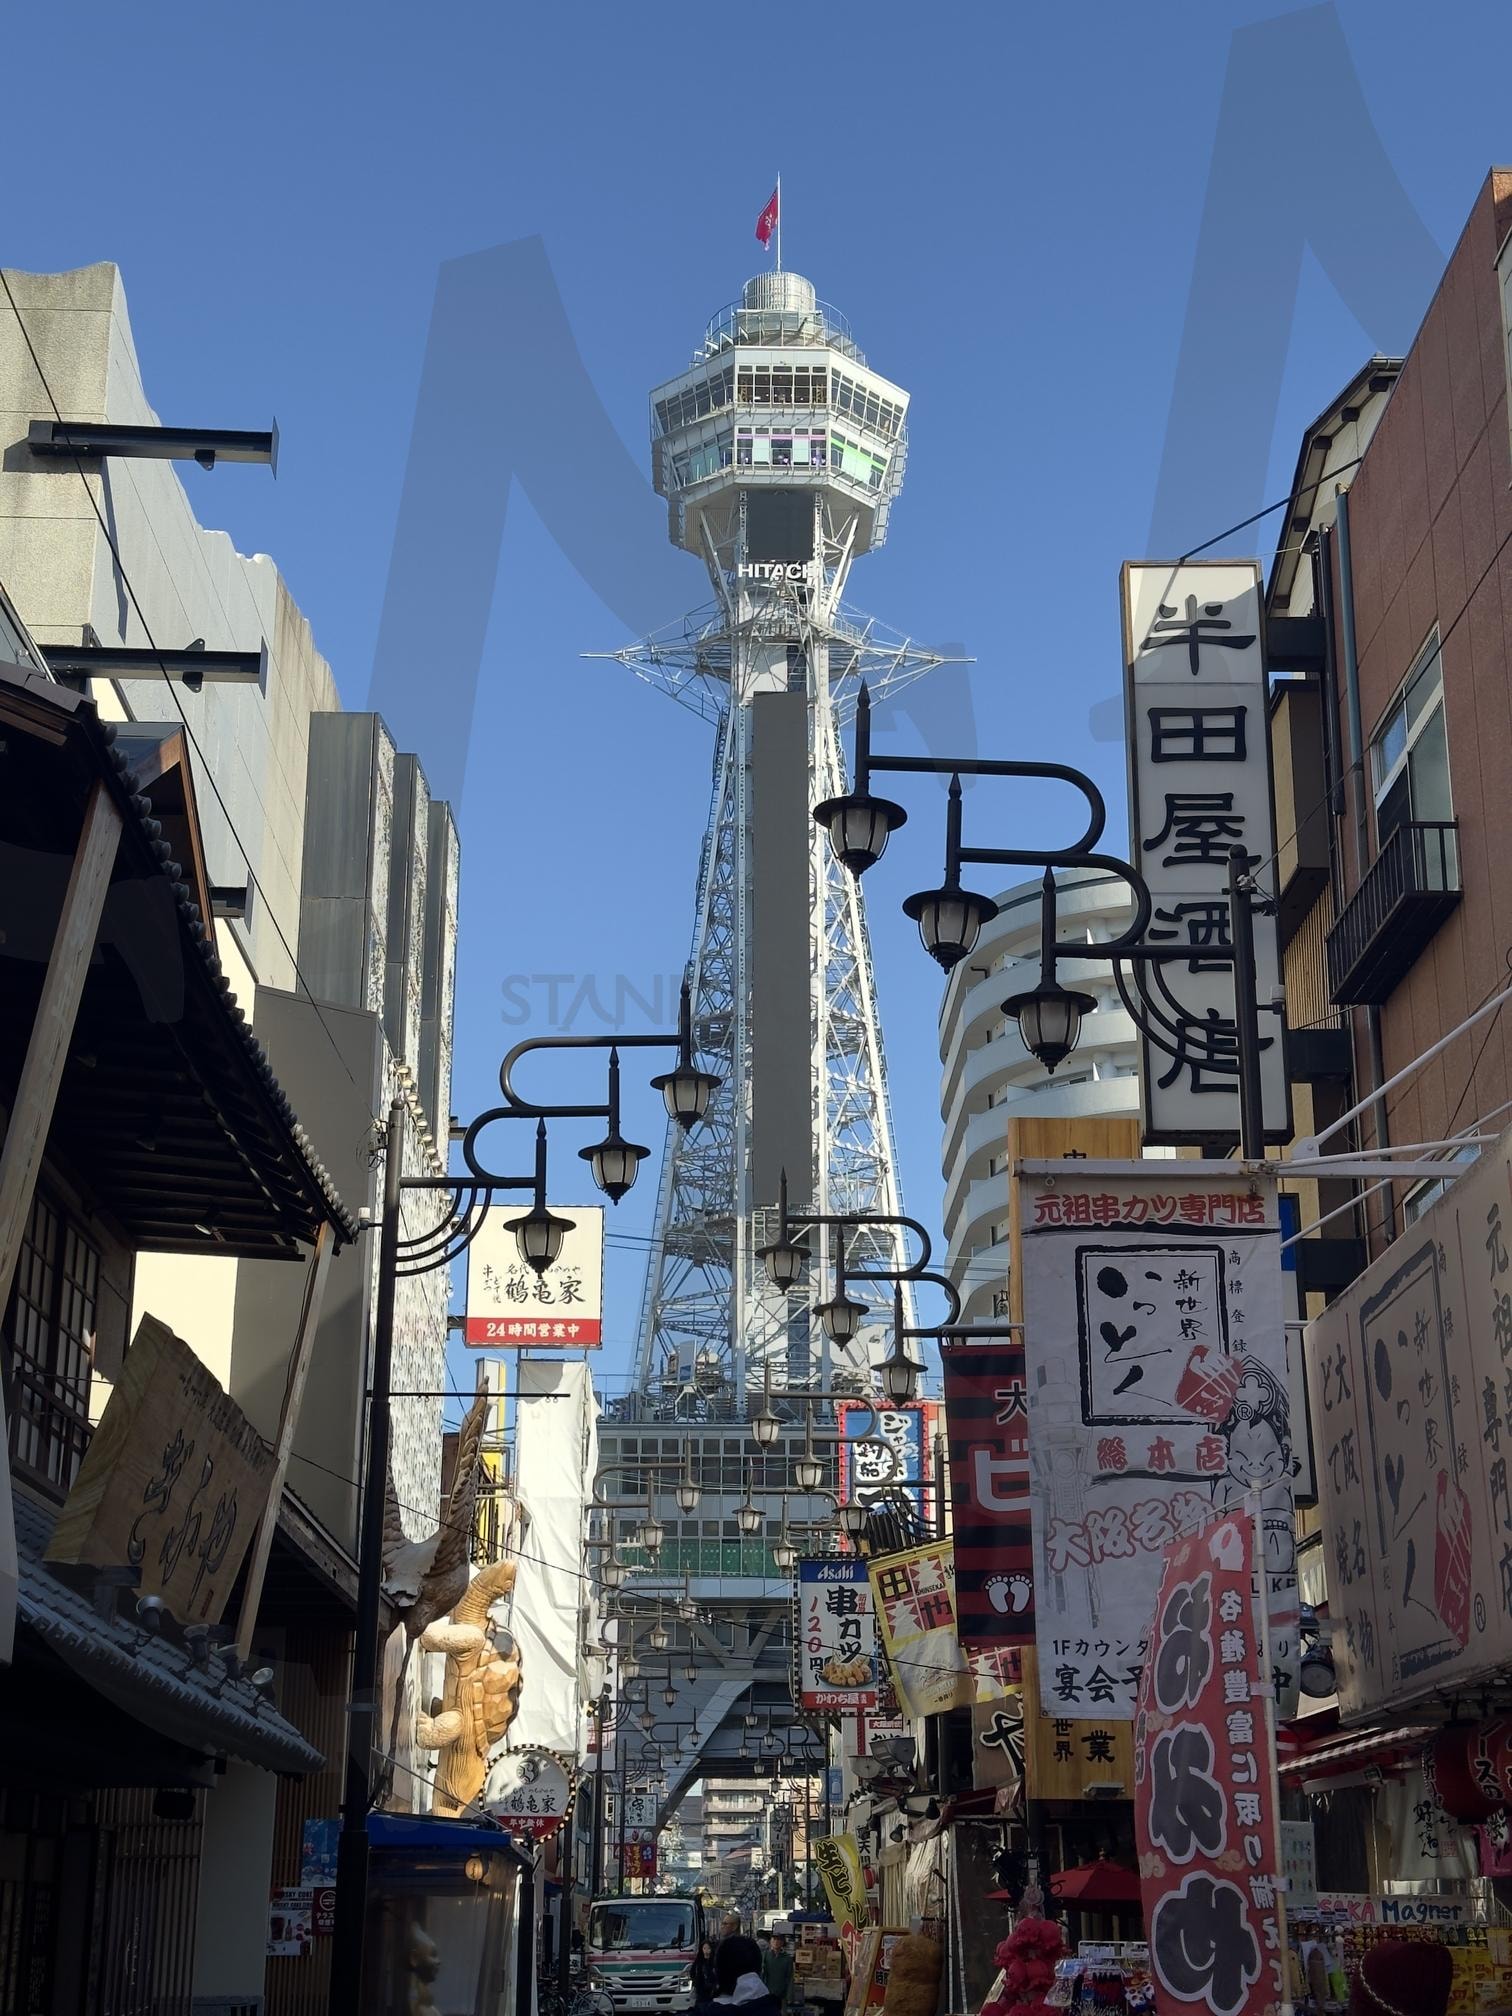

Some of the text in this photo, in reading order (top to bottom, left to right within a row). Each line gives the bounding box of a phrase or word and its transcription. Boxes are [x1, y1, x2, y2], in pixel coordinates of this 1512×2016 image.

[1034, 1193, 1266, 1224] 元祖串カツ専門店
[505, 1274, 586, 1304] 鶴亀家
[1228, 1250, 1248, 1353] 商標登録
[1173, 1269, 1209, 1342] 新世界
[486, 1322, 580, 1338] 24時間営業中
[1095, 1435, 1230, 1472] 総本店
[817, 1564, 854, 1580] Asahi
[825, 1585, 861, 1664] 串カツ
[510, 1794, 557, 1814] 鶴亀家
